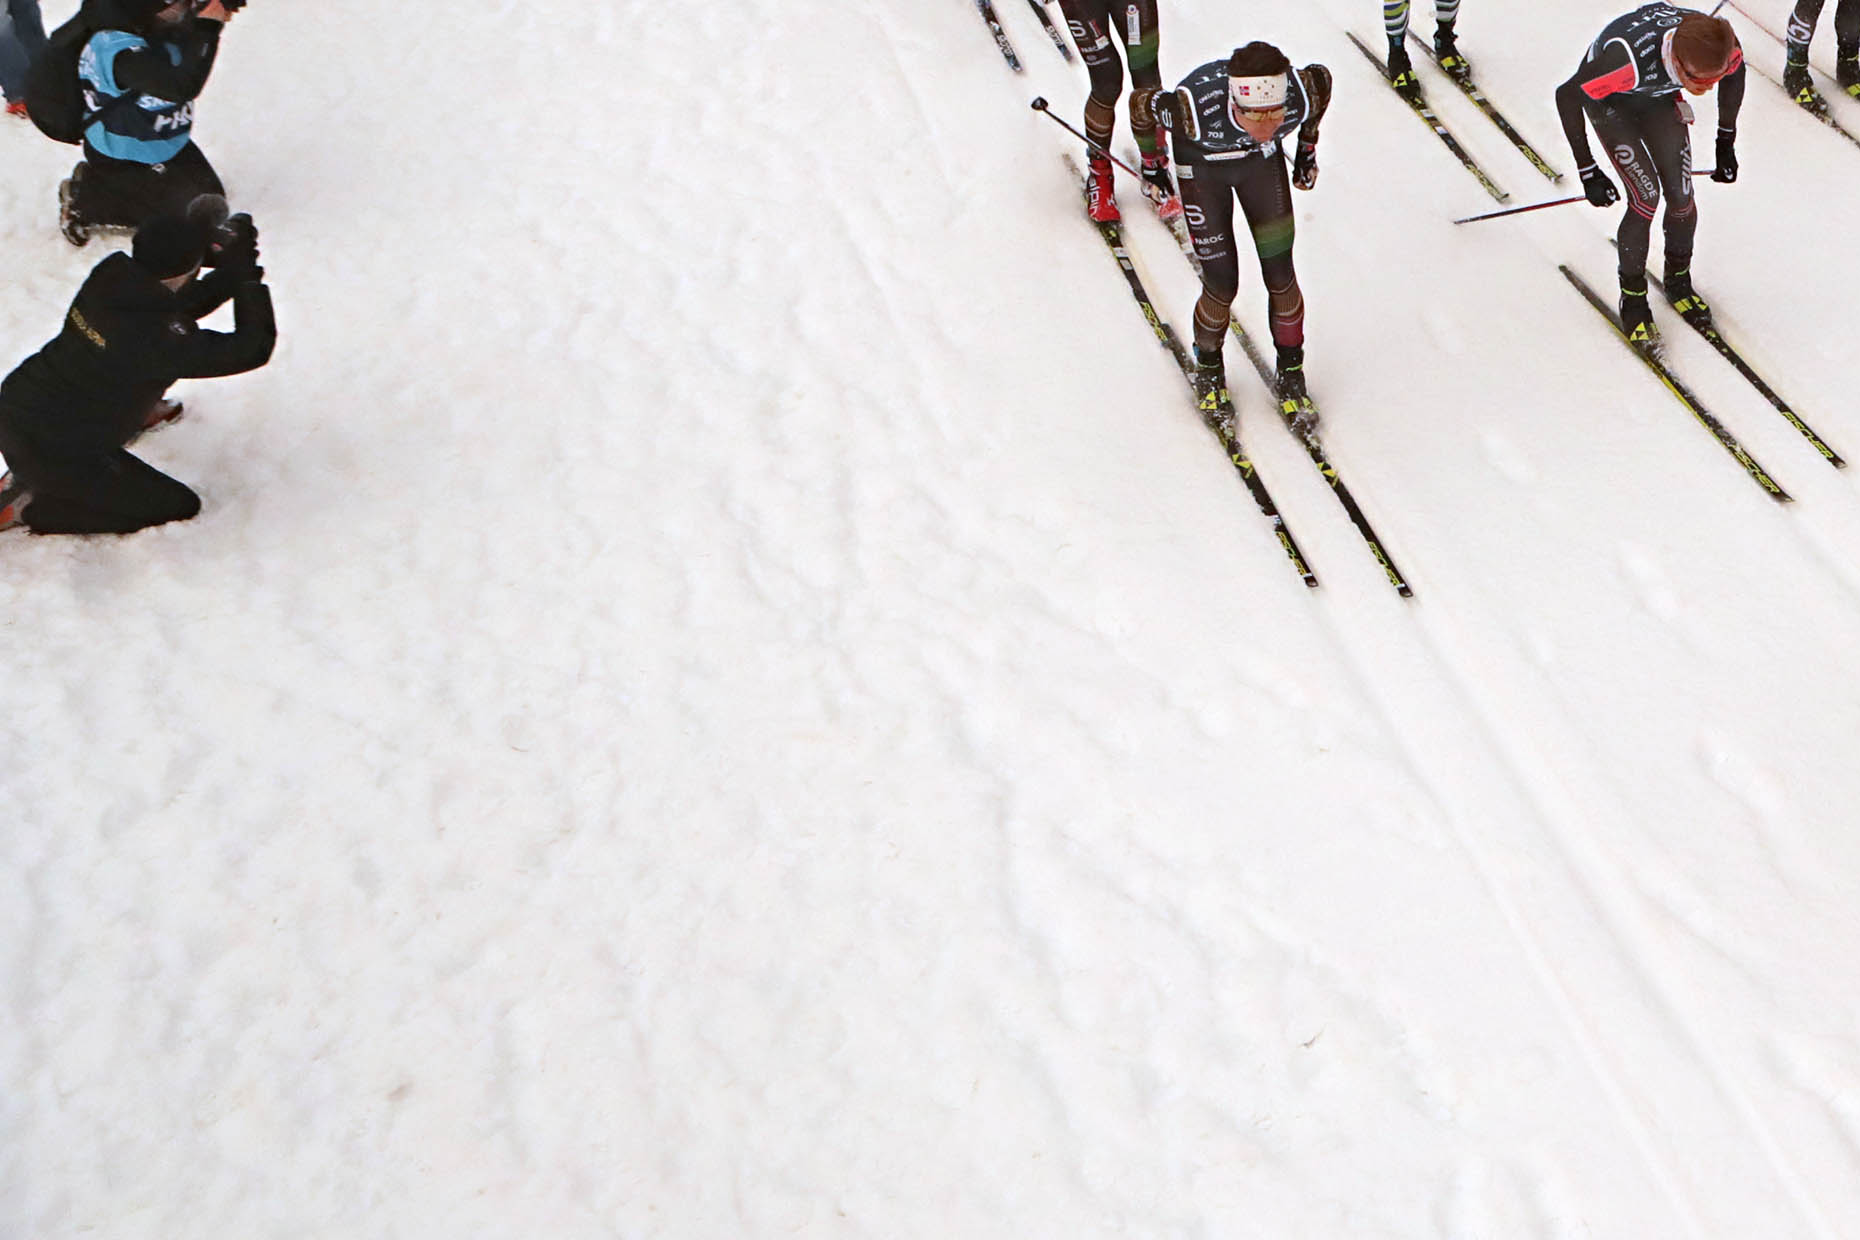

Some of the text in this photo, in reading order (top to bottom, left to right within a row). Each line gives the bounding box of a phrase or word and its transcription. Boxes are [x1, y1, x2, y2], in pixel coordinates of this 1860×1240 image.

[1626, 165, 1650, 200] Eiendom
[1630, 153, 1659, 199] RAGDE
[1781, 411, 1835, 459] FISCHER
